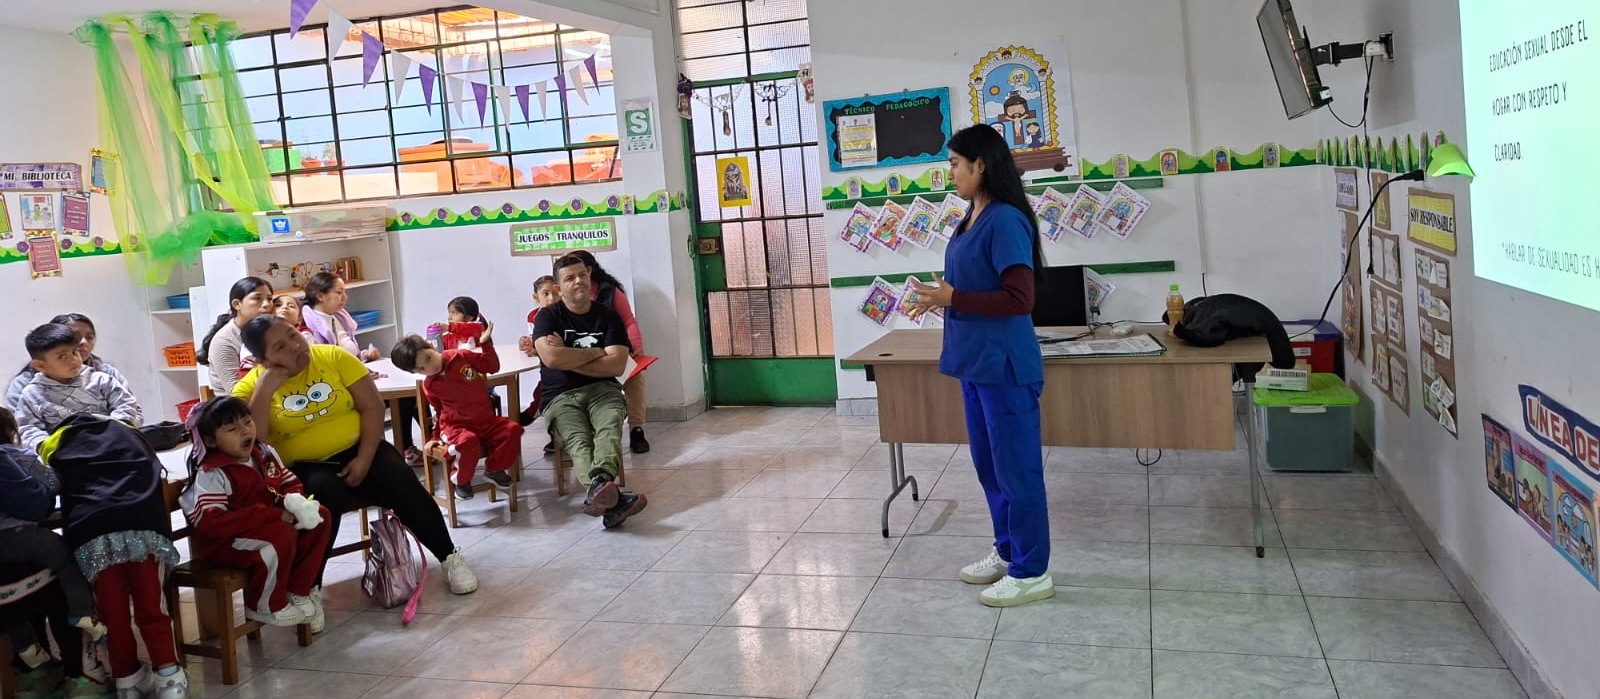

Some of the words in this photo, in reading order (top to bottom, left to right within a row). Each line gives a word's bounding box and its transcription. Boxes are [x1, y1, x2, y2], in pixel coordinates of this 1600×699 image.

[1489, 41, 1522, 73] EDUCACIÓN
[1524, 34, 1549, 61] SEXUAL
[1550, 24, 1575, 52] DESDE
[1577, 19, 1588, 42] EL
[1512, 91, 1527, 113] CON
[1528, 82, 1560, 110] RESPETO
[1561, 80, 1567, 102] Y
[630, 111, 648, 134] S
[4, 172, 15, 181] MI
[22, 171, 72, 181] BIBLIOTECA
[1410, 207, 1419, 223] SOY
[1419, 210, 1453, 233] RESPONSABLE
[519, 233, 550, 243] JUEGOS
[556, 229, 608, 241] TRANQUILOS
[1527, 245, 1536, 266] DE
[1537, 246, 1579, 275] SEXUALIDAD
[1581, 254, 1592, 278] ES
[1527, 395, 1574, 453] LÍNEA
[1575, 429, 1600, 471] DE
